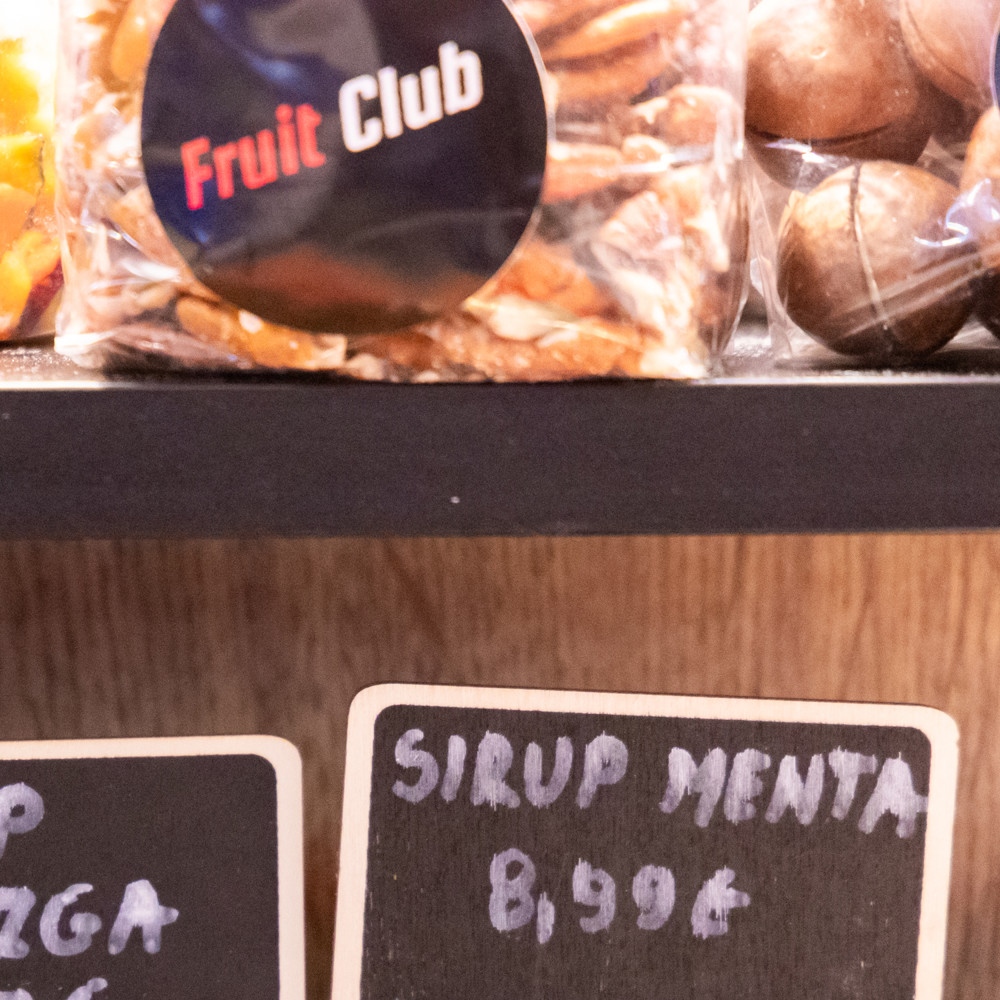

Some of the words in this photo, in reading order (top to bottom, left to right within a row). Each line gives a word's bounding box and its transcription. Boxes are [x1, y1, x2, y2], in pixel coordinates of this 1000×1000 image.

[180, 103, 326, 211] Fruit
[338, 40, 483, 153] Club
[392, 728, 629, 809] SIRUP
[659, 746, 928, 839] MENTA
